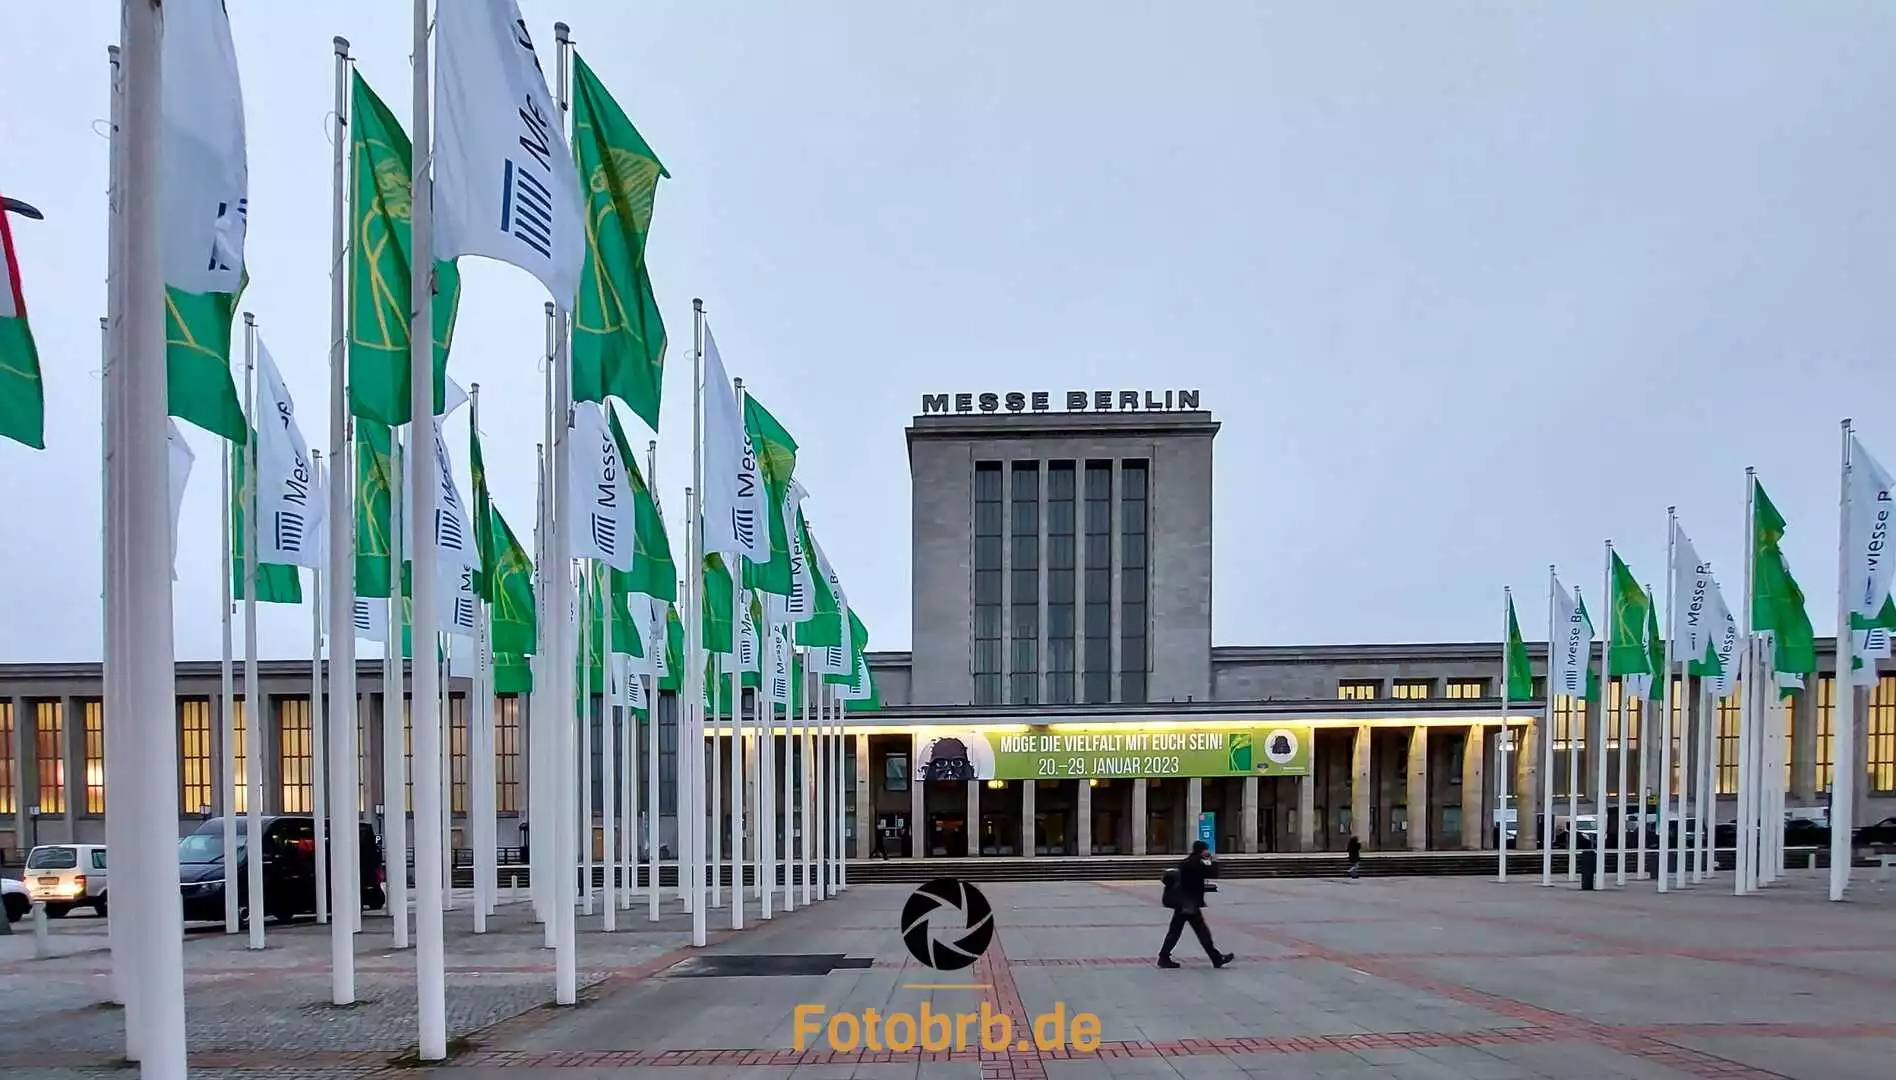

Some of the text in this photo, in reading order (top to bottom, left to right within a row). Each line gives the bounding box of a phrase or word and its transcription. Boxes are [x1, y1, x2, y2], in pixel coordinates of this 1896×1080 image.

[922, 390, 1200, 412] MESSE BERLIN
[1687, 580, 1707, 627] Messe
[1567, 628, 1580, 666] Messe
[1718, 627, 1736, 666] Messe
[1001, 733, 1223, 753] MÖGE DIE VIELFALT MIT EUCH SEIN!
[1091, 756, 1142, 775] JANUAR
[1144, 756, 1180, 774] 2023
